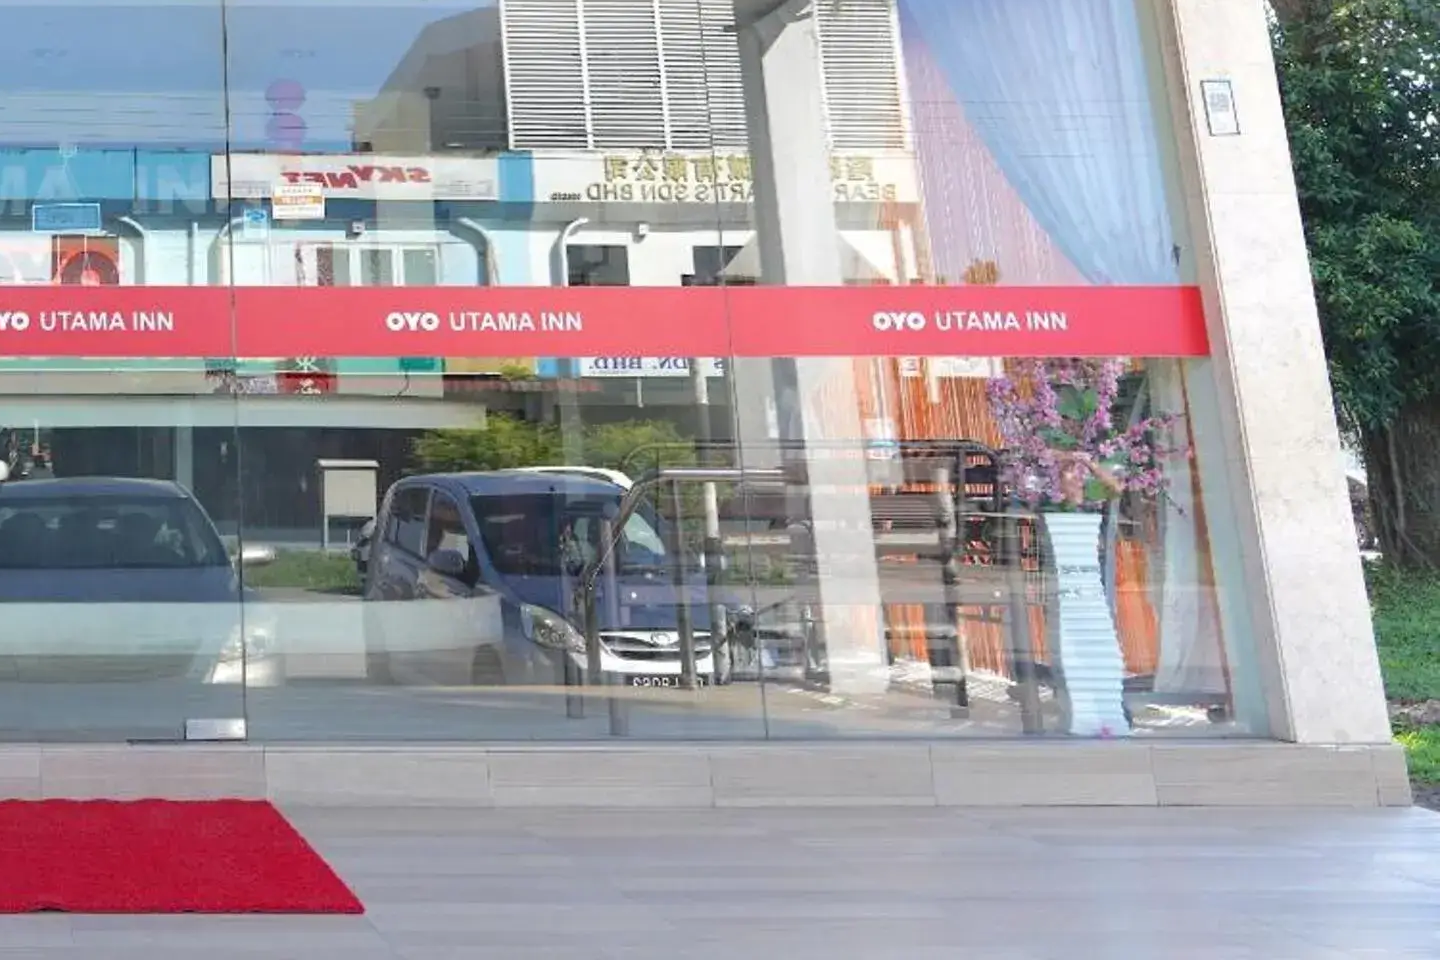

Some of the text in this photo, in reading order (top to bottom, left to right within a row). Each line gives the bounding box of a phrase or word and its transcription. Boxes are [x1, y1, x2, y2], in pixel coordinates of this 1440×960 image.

[39, 311, 127, 331] UTAMA
[132, 311, 175, 331] INN
[385, 311, 583, 331] OYO UTAMA INN
[872, 311, 1068, 331] OYO UTAMA INN
